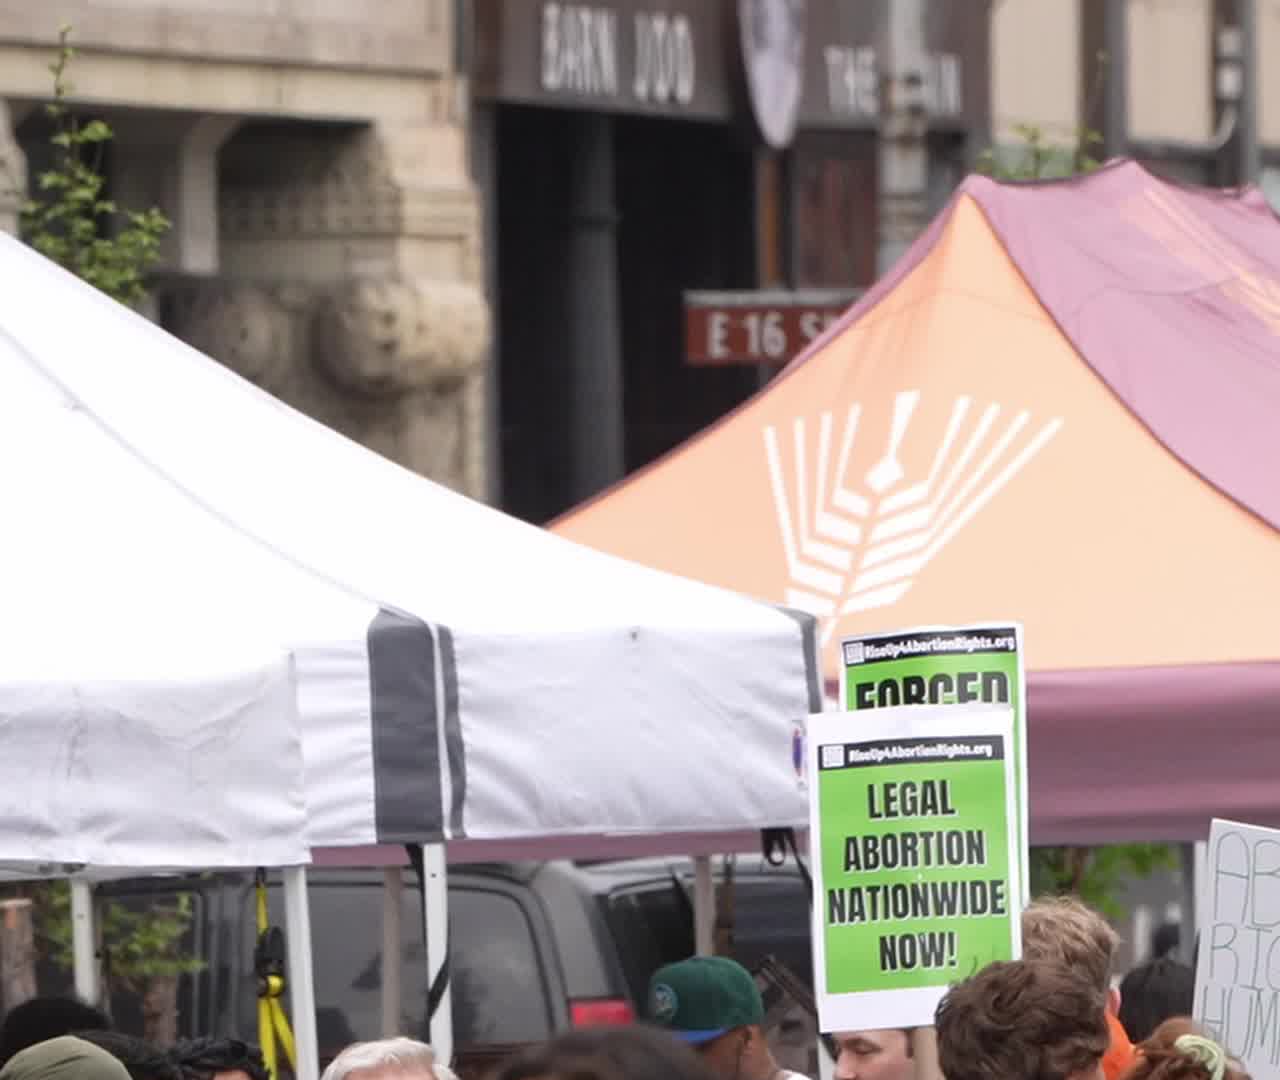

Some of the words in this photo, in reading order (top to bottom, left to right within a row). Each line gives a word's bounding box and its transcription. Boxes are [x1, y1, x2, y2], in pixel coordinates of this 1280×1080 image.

[706, 313, 729, 358] E
[741, 312, 787, 356] 16
[867, 779, 956, 819] LEGAL
[843, 829, 986, 873] ABORTION
[827, 879, 1006, 924] NATIONWIDE
[879, 931, 957, 971] NOW!
